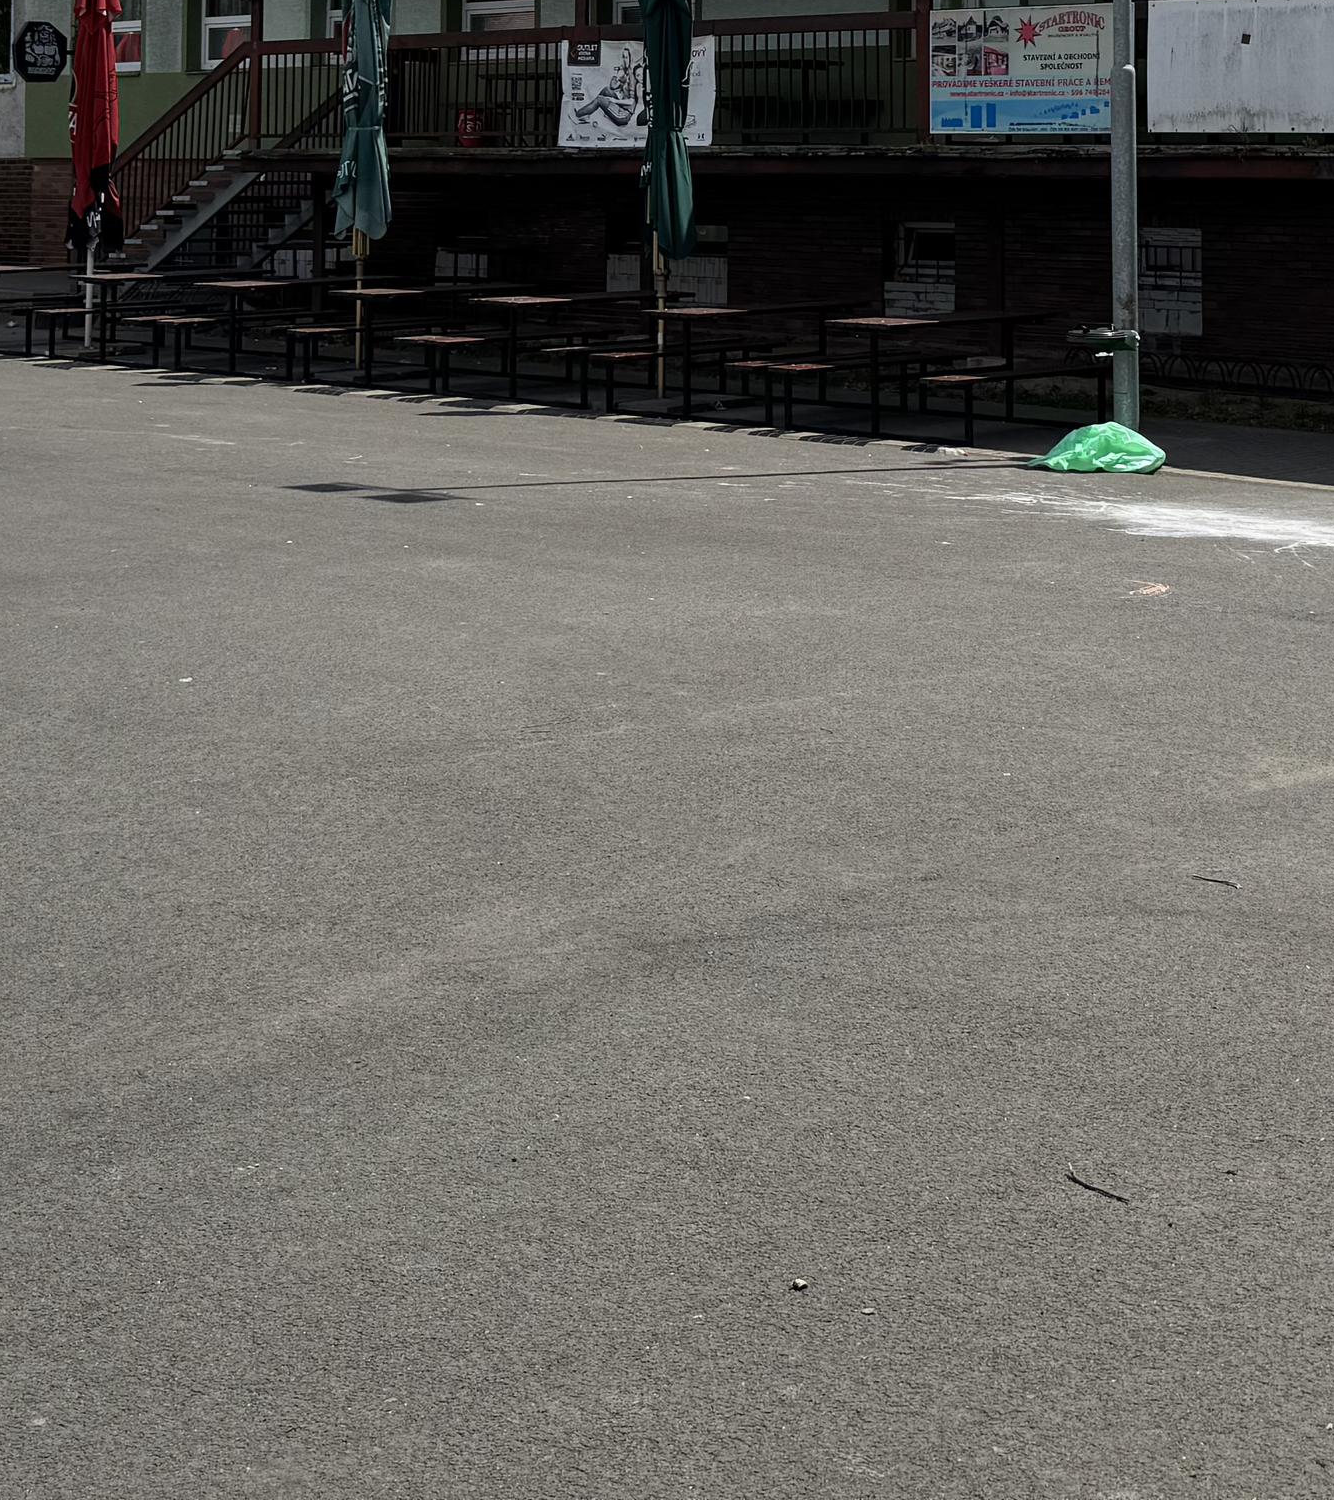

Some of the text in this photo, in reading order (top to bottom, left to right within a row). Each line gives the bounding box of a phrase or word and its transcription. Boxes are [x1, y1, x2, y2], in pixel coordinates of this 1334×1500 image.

[1038, 11, 1105, 32] STARTRONIC
[1023, 52, 1056, 61] STAVEBNÍ
[1064, 52, 1100, 61] OBCHODNÍ
[1040, 62, 1083, 70] SPOLEČNOST
[932, 78, 977, 88] PROVÁDÍME
[978, 78, 1014, 88] VEŠKERÉ
[1015, 77, 1055, 87] STAVEBNÍ
[1057, 78, 1084, 87] PRÁCE
